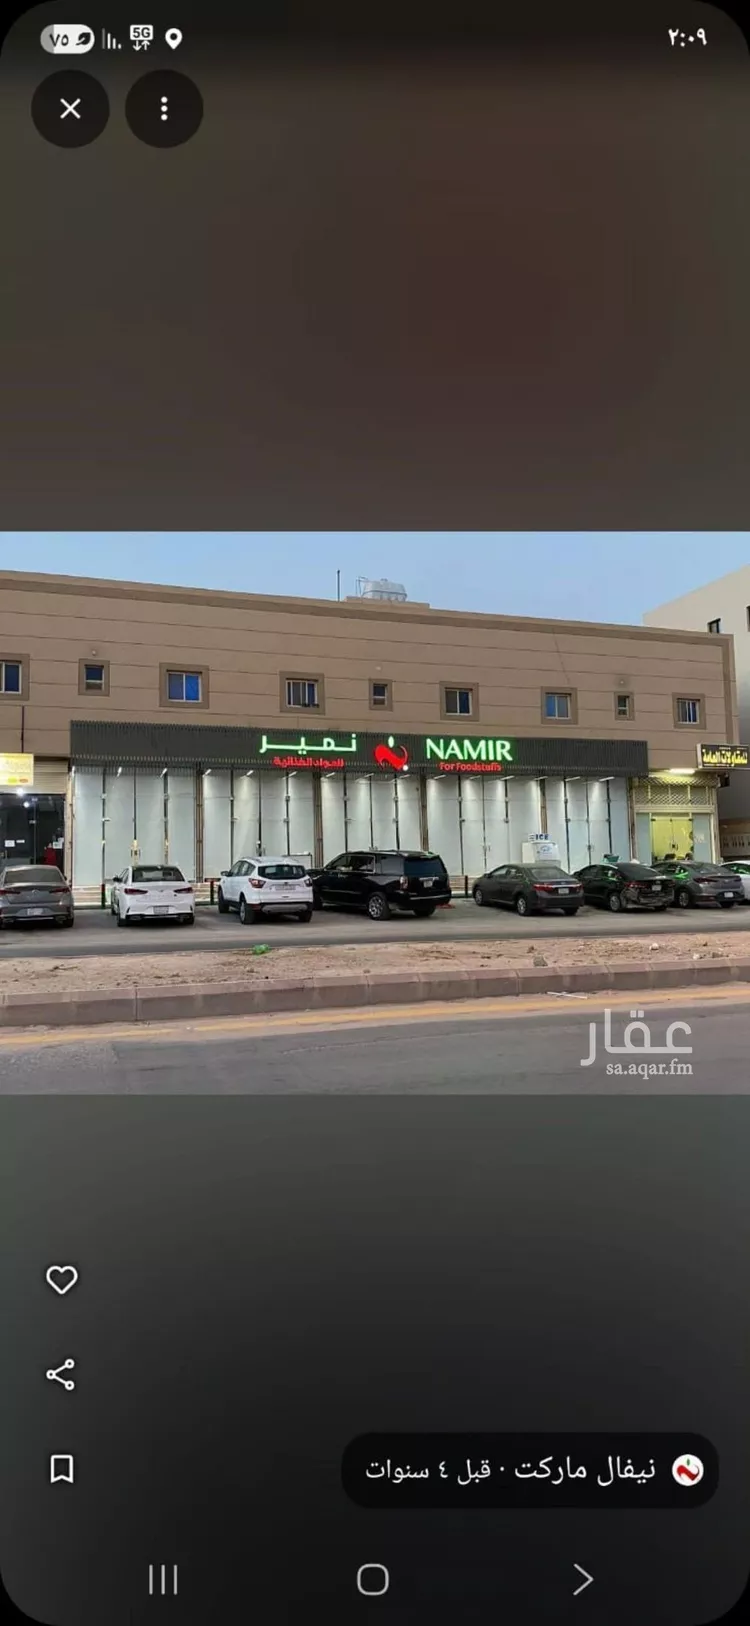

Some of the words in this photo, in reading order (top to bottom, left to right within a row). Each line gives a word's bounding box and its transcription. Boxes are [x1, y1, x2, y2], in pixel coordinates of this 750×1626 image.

[259, 733, 356, 755] نمير
[426, 738, 513, 761] NAMIR
[313, 758, 344, 768] للمواد
[440, 762, 455, 771] For
[456, 762, 502, 772] Foodstuffs
